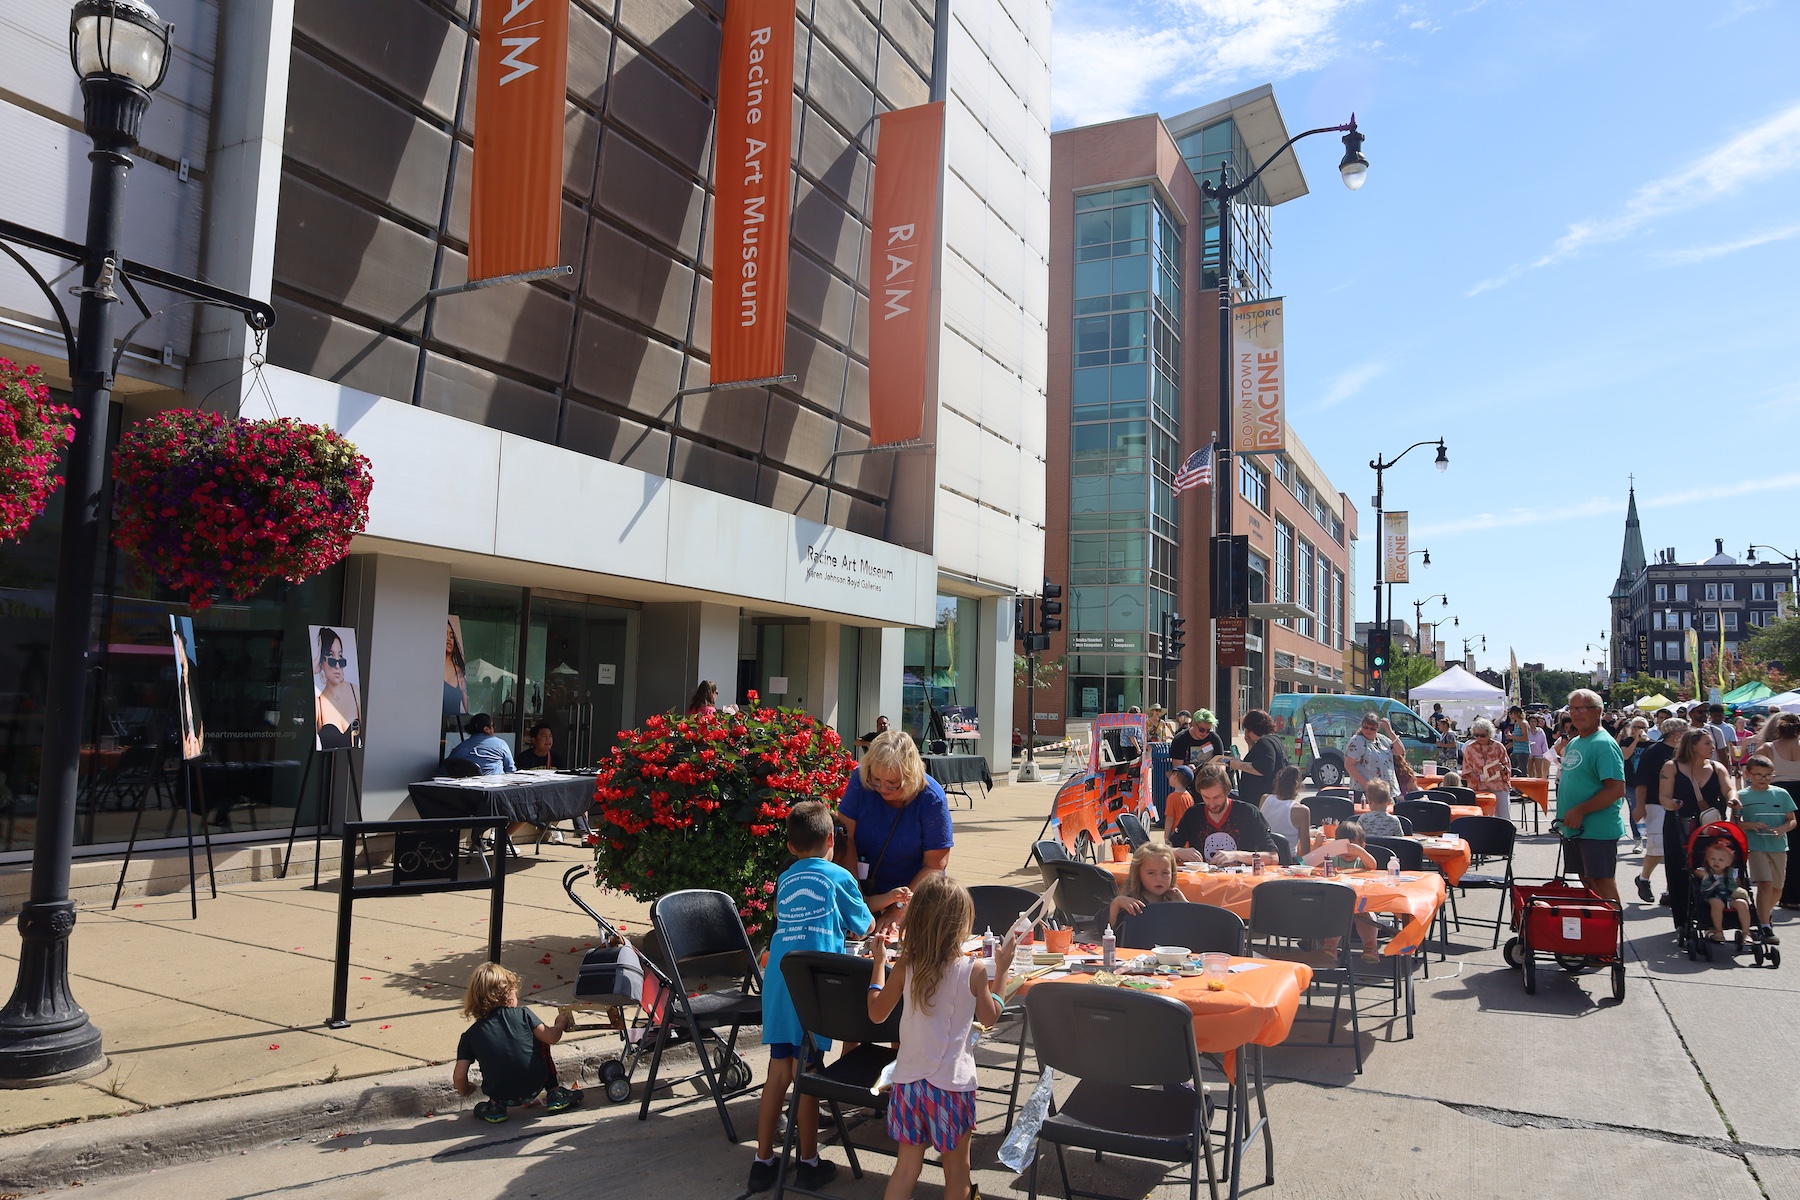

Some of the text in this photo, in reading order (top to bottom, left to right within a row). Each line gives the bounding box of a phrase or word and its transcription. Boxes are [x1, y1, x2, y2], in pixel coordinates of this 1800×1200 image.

[741, 26, 771, 327] Racine Art Museum
[1235, 308, 1281, 320] HISTORIC
[1244, 315, 1271, 338] Hip
[1241, 353, 1252, 447] DOWNTOWN
[1257, 350, 1280, 446] RACINE
[807, 545, 894, 580] Racine Art Museum
[1396, 536, 1406, 580] RACINE
[806, 567, 882, 592] Karen Johnson Boyd Galleries
[1640, 635, 1648, 670] DEWEY
[204, 731, 297, 739] neartmuseumstore.org
